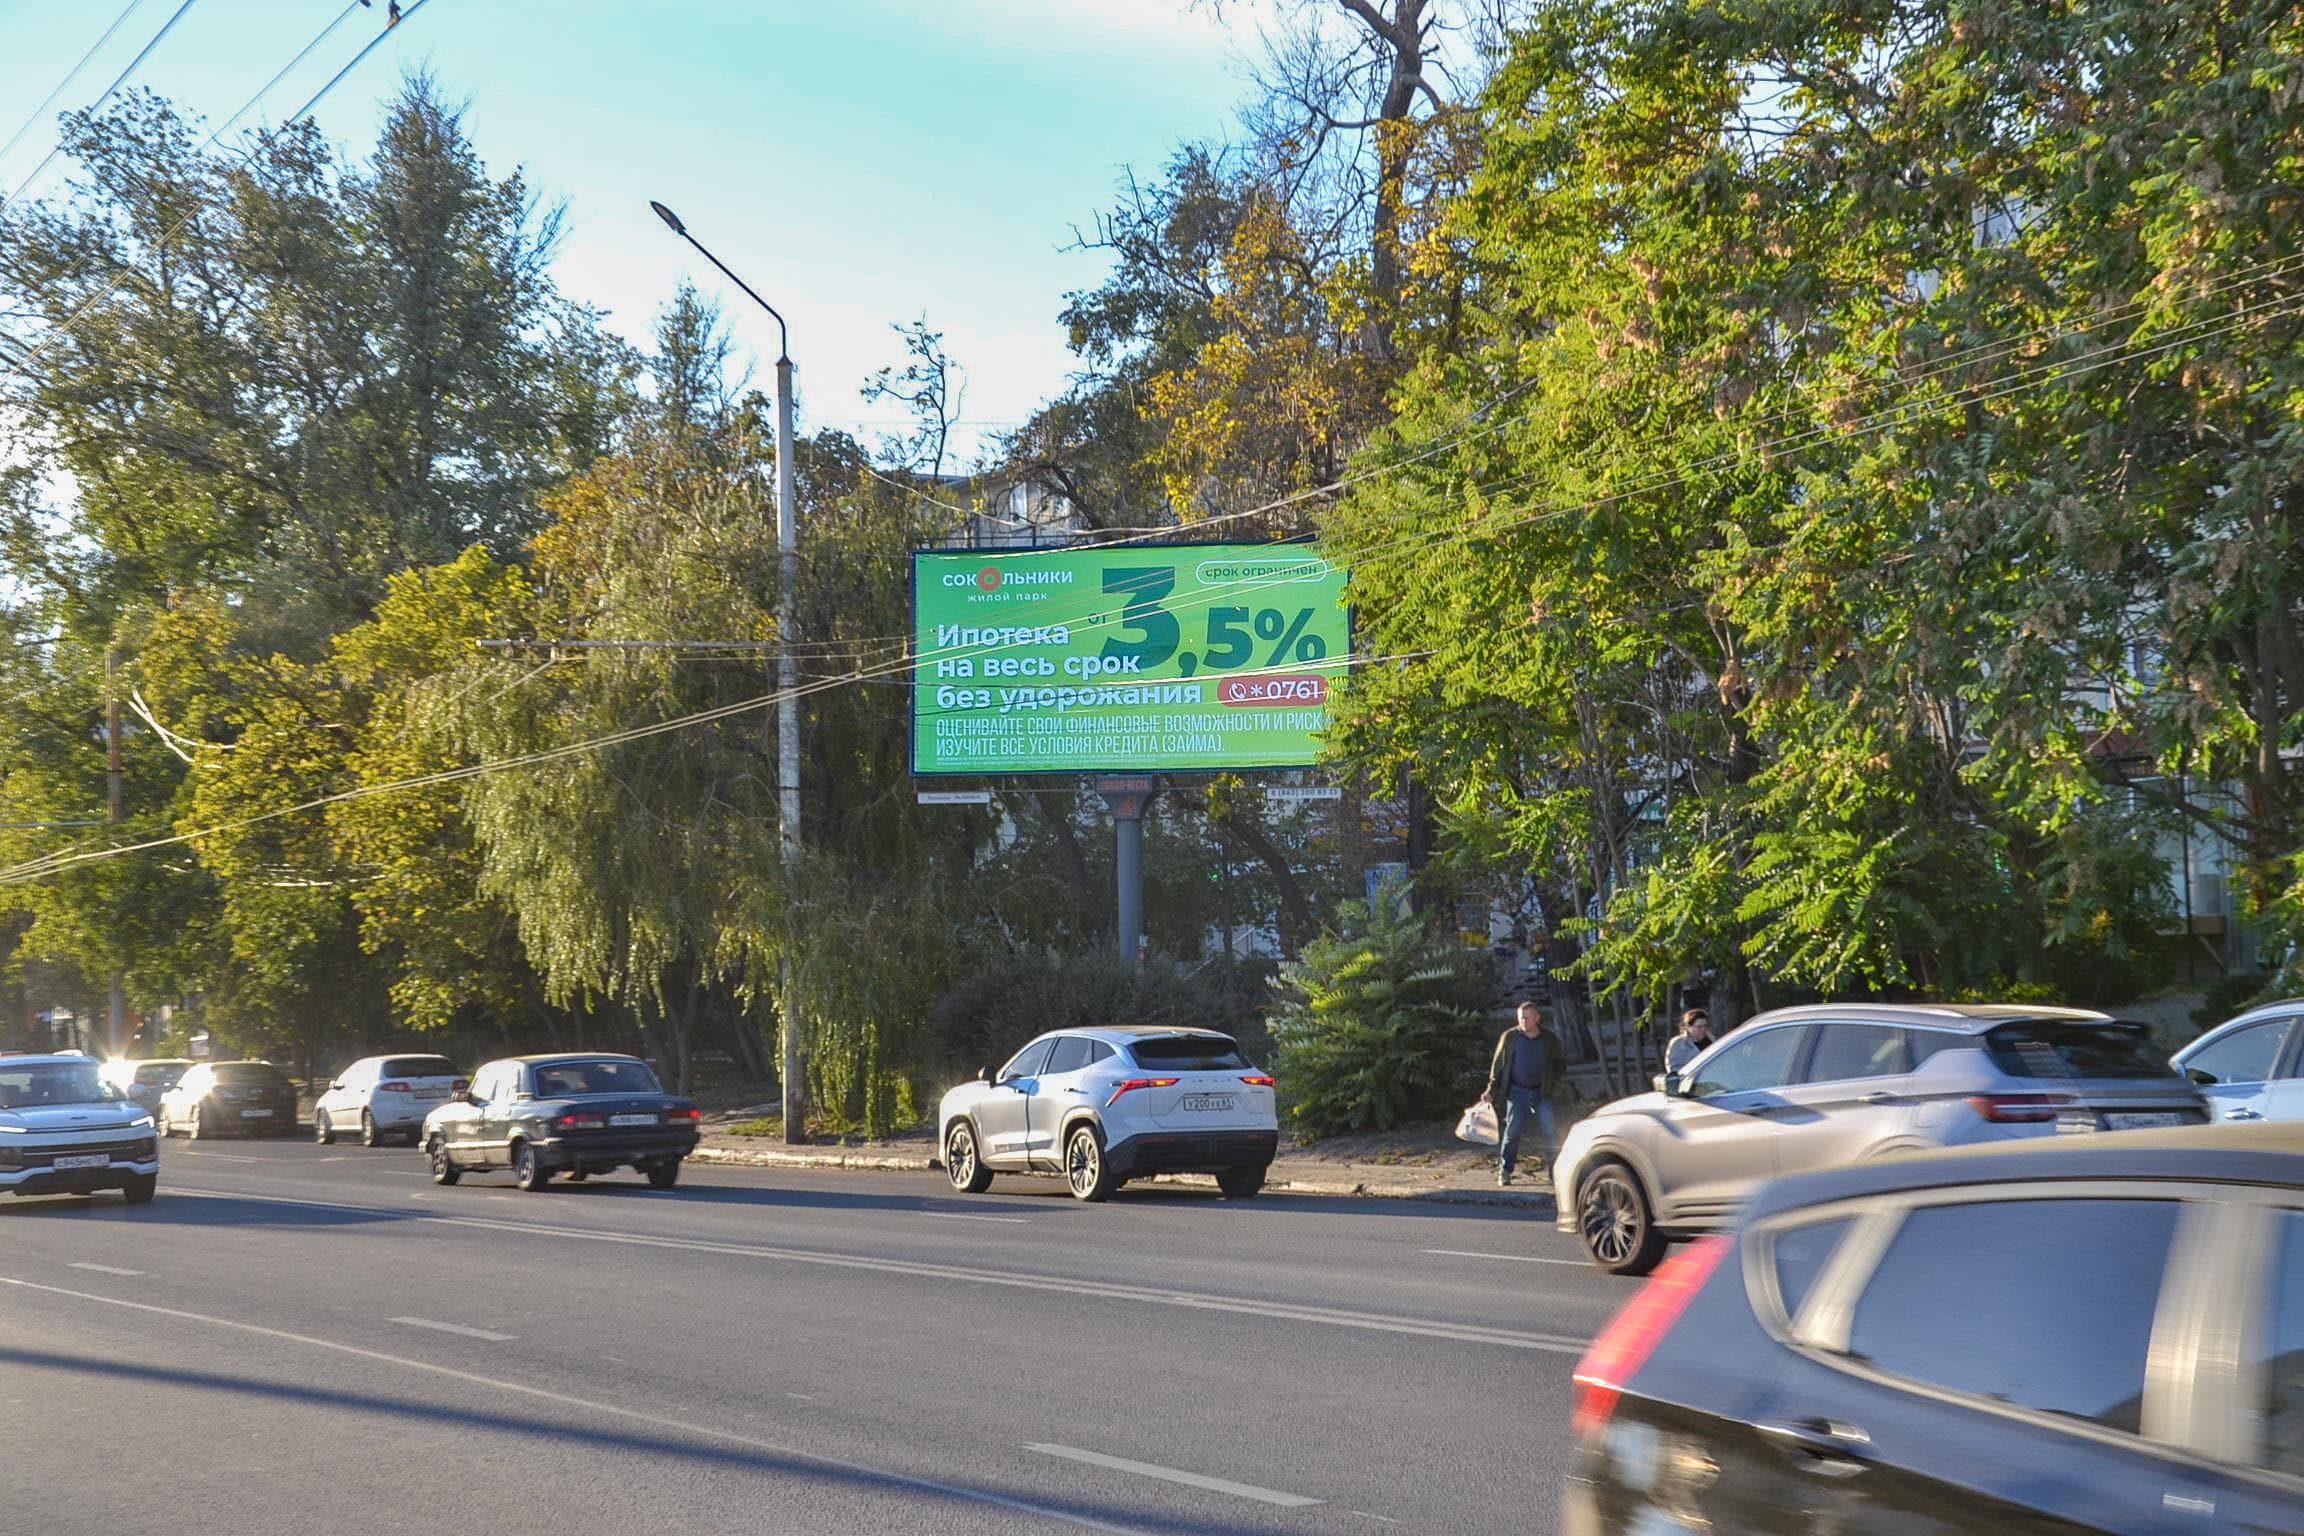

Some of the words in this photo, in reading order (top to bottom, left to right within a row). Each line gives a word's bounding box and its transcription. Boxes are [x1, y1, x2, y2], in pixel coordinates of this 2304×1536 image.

[1205, 568, 1238, 579] срок
[967, 592, 1010, 602] жилой
[1016, 592, 1049, 602] парк
[938, 623, 1070, 647] Ипотека
[937, 658, 974, 678] на
[983, 656, 1056, 677] весь
[1063, 654, 1141, 681] срок
[936, 685, 992, 709] без
[999, 685, 1202, 714] удорожания
[936, 715, 1024, 738] ОЦЕНИВАЙТЕ
[1027, 716, 1063, 736] СВОИ
[1066, 714, 1161, 735] ФИНАНСОВЫЕ
[1164, 712, 1270, 732] ВОЗМОЖНОСТИ
[1273, 712, 1284, 731] И
[936, 737, 998, 756] ИЗУЧИТЕ
[1001, 736, 1026, 755] ВСЕ
[1028, 735, 1092, 755] УСЛОВИЯ
[1094, 733, 1159, 755] КРЕДИТА
